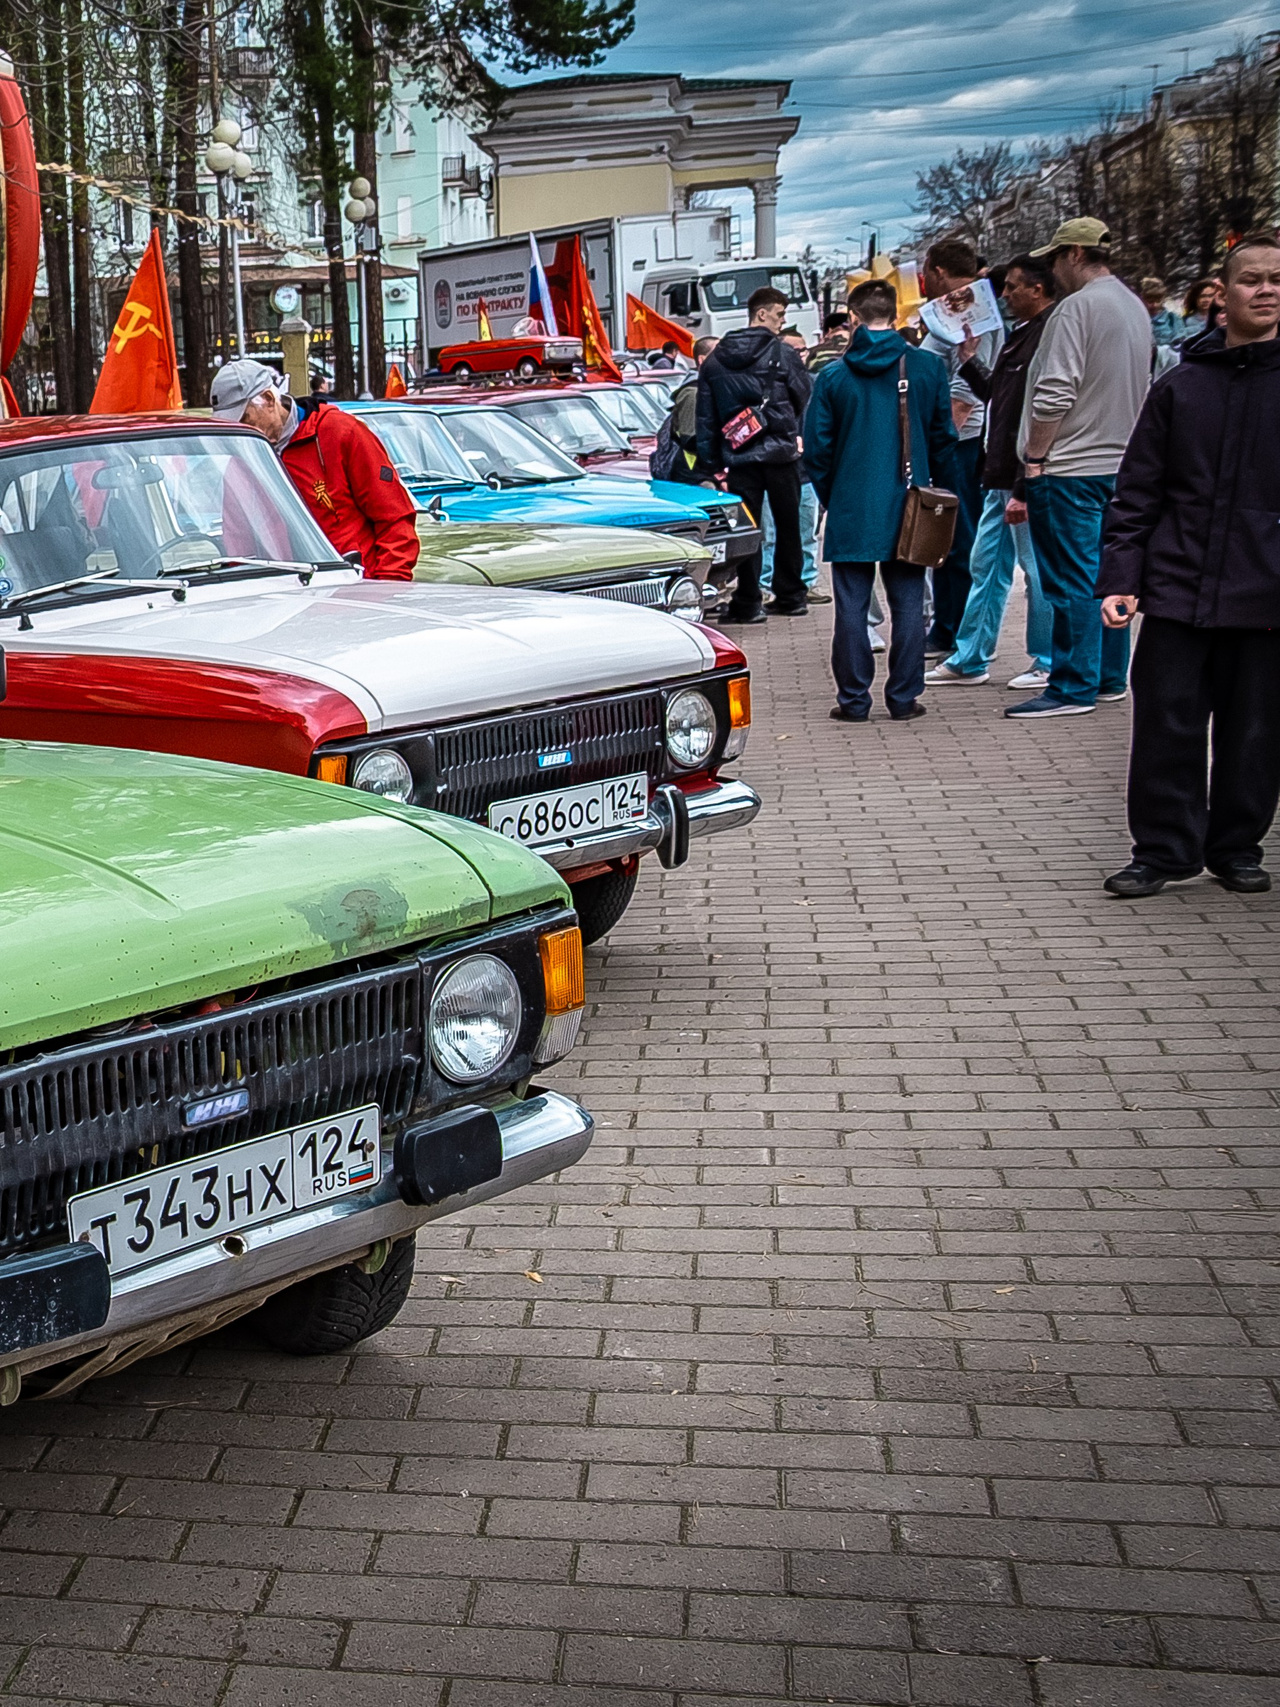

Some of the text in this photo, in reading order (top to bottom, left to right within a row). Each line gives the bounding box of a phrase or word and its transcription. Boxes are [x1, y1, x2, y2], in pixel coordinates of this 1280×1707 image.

[456, 293, 465, 301] НА
[497, 283, 526, 295] СЛУЖБУ
[456, 304, 470, 317] ПО
[472, 296, 526, 315] КНТРАКТУ
[605, 779, 642, 811] 124
[612, 808, 631, 821] RUS
[90, 1117, 369, 1265] Т343НХ 124
[312, 1170, 347, 1196] RUS
